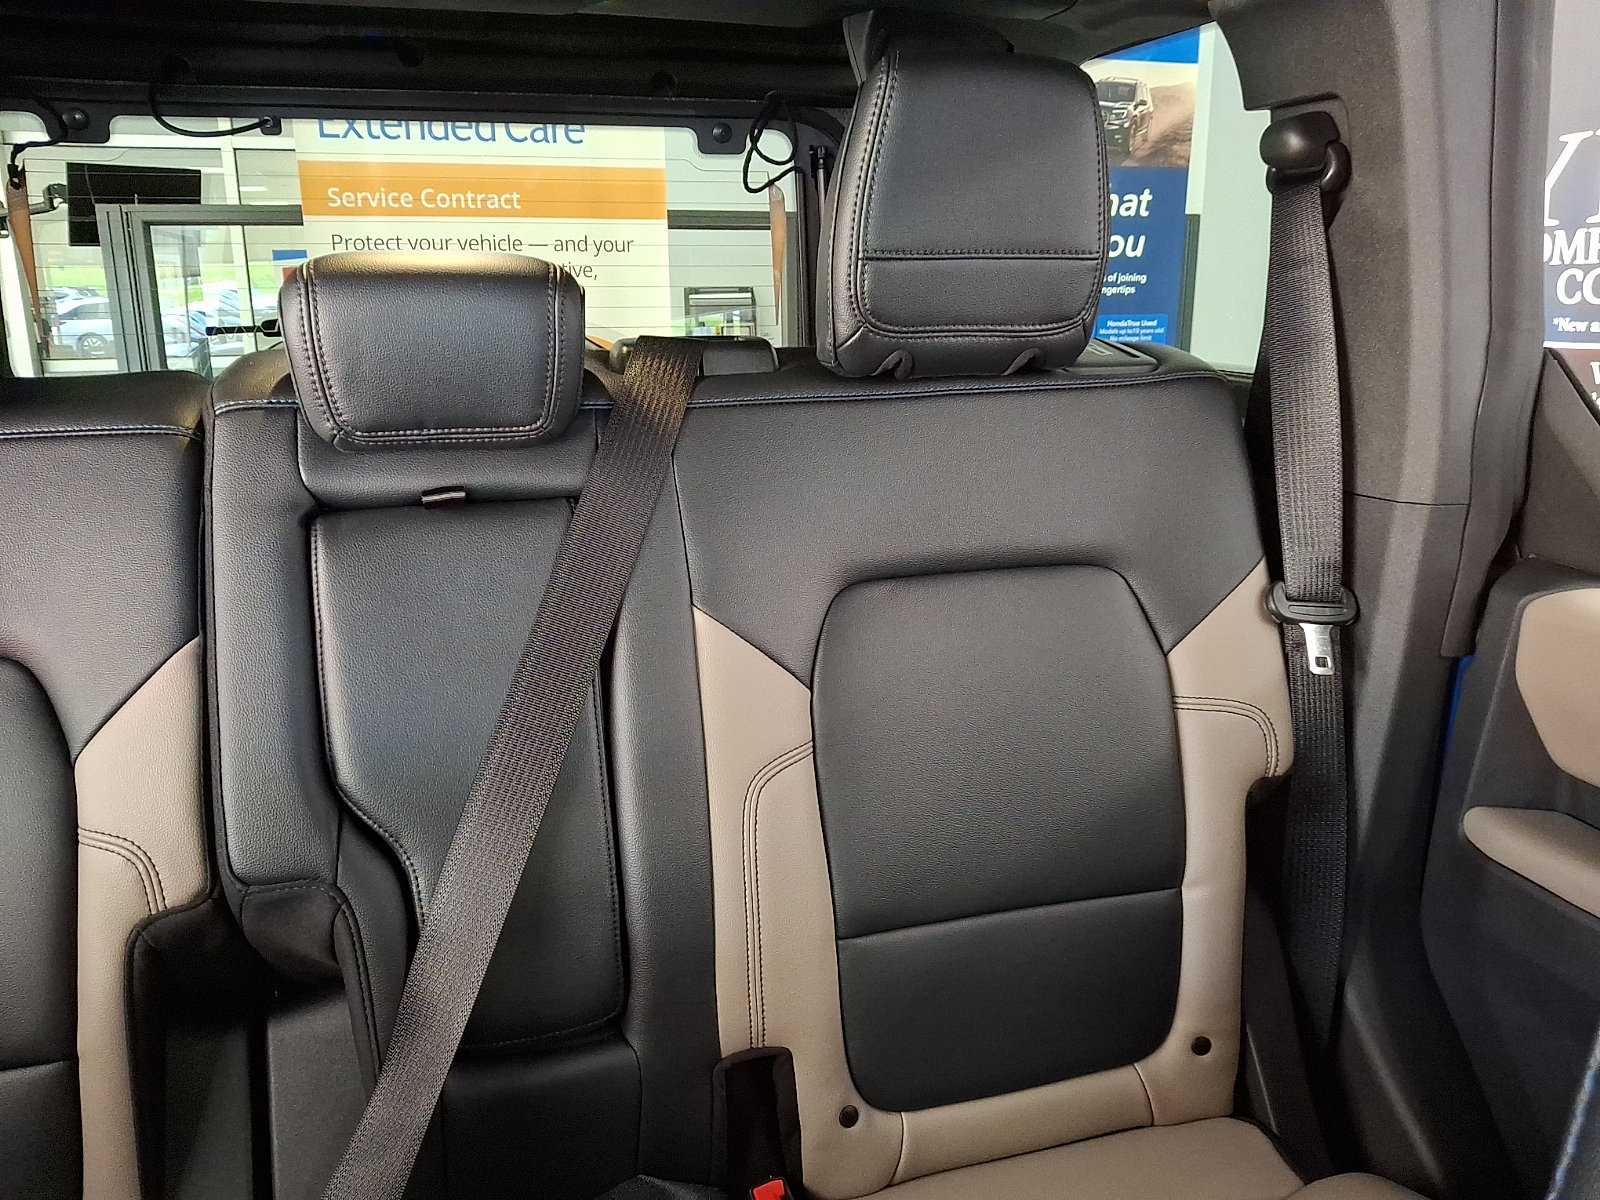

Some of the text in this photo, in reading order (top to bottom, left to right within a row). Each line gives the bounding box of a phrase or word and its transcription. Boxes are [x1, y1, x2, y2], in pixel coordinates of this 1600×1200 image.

[318, 118, 585, 144] Extended Care
[327, 187, 521, 210] Service Contract
[331, 234, 402, 251] Protect
[407, 237, 452, 251] your
[457, 234, 523, 252] vehicle
[554, 235, 588, 252] and
[592, 238, 634, 257] your
[1107, 272, 1147, 284] of joining
